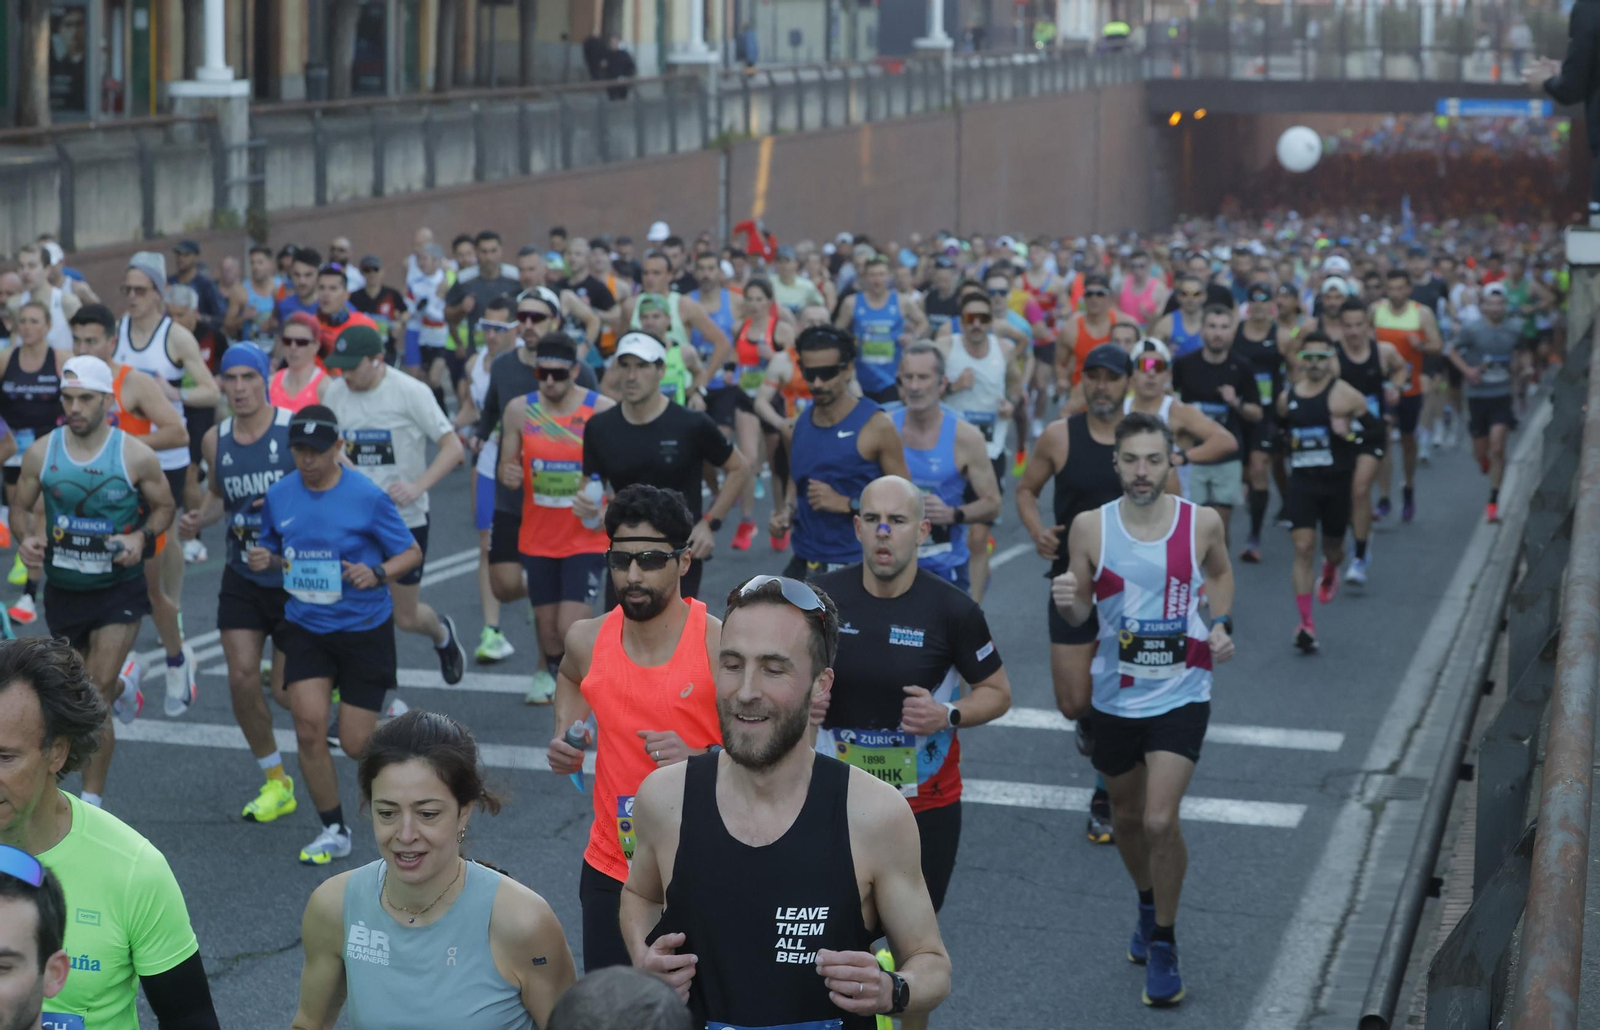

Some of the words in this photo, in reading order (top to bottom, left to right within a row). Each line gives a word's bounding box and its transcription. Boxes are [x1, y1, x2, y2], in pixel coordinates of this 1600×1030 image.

[358, 432, 388, 440] ZURICH
[356, 453, 382, 466] EDDY
[545, 461, 576, 470] ZURICH
[71, 520, 107, 531] ZURICH
[298, 550, 332, 559] ZURICH
[292, 577, 330, 590] FAOUZI
[1167, 576, 1180, 619] AMBAS
[1143, 621, 1182, 632] ZURICH
[1132, 651, 1174, 665] JORDI
[860, 734, 906, 745] ZURICH
[862, 755, 886, 765] 1898
[775, 906, 830, 920] LEAVE
[776, 922, 826, 936] THEM
[774, 937, 807, 950] ALL
[346, 950, 390, 966] RUNNERS
[775, 950, 817, 965] BEHI
